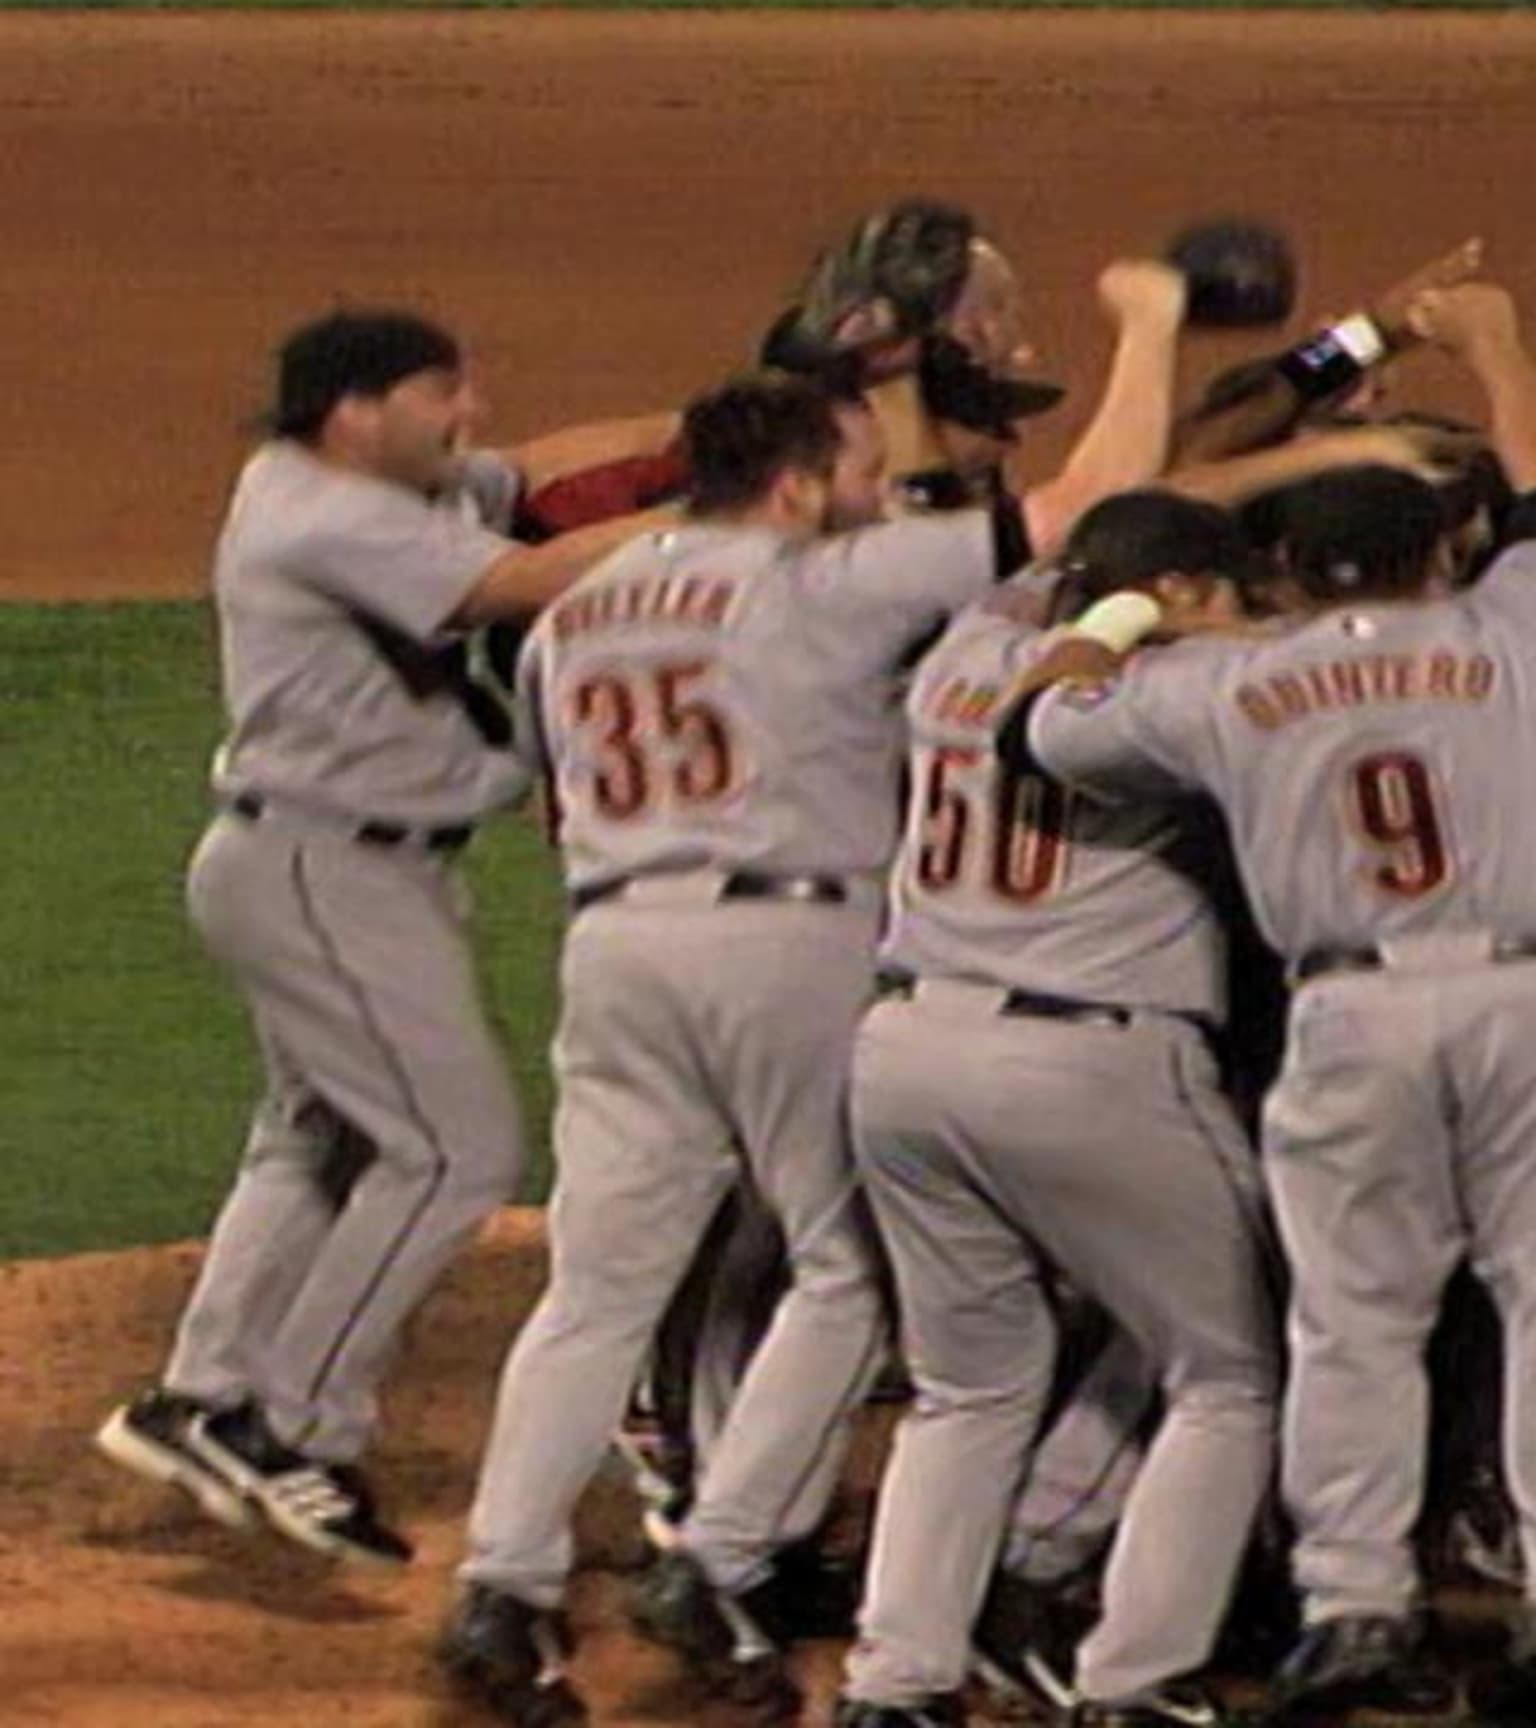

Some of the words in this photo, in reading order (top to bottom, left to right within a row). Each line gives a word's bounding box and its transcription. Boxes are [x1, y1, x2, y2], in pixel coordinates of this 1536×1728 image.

[570, 660, 738, 824] 35
[1232, 645, 1498, 732] QUINTERO
[916, 744, 1066, 904] 50
[1348, 748, 1452, 900] 9
